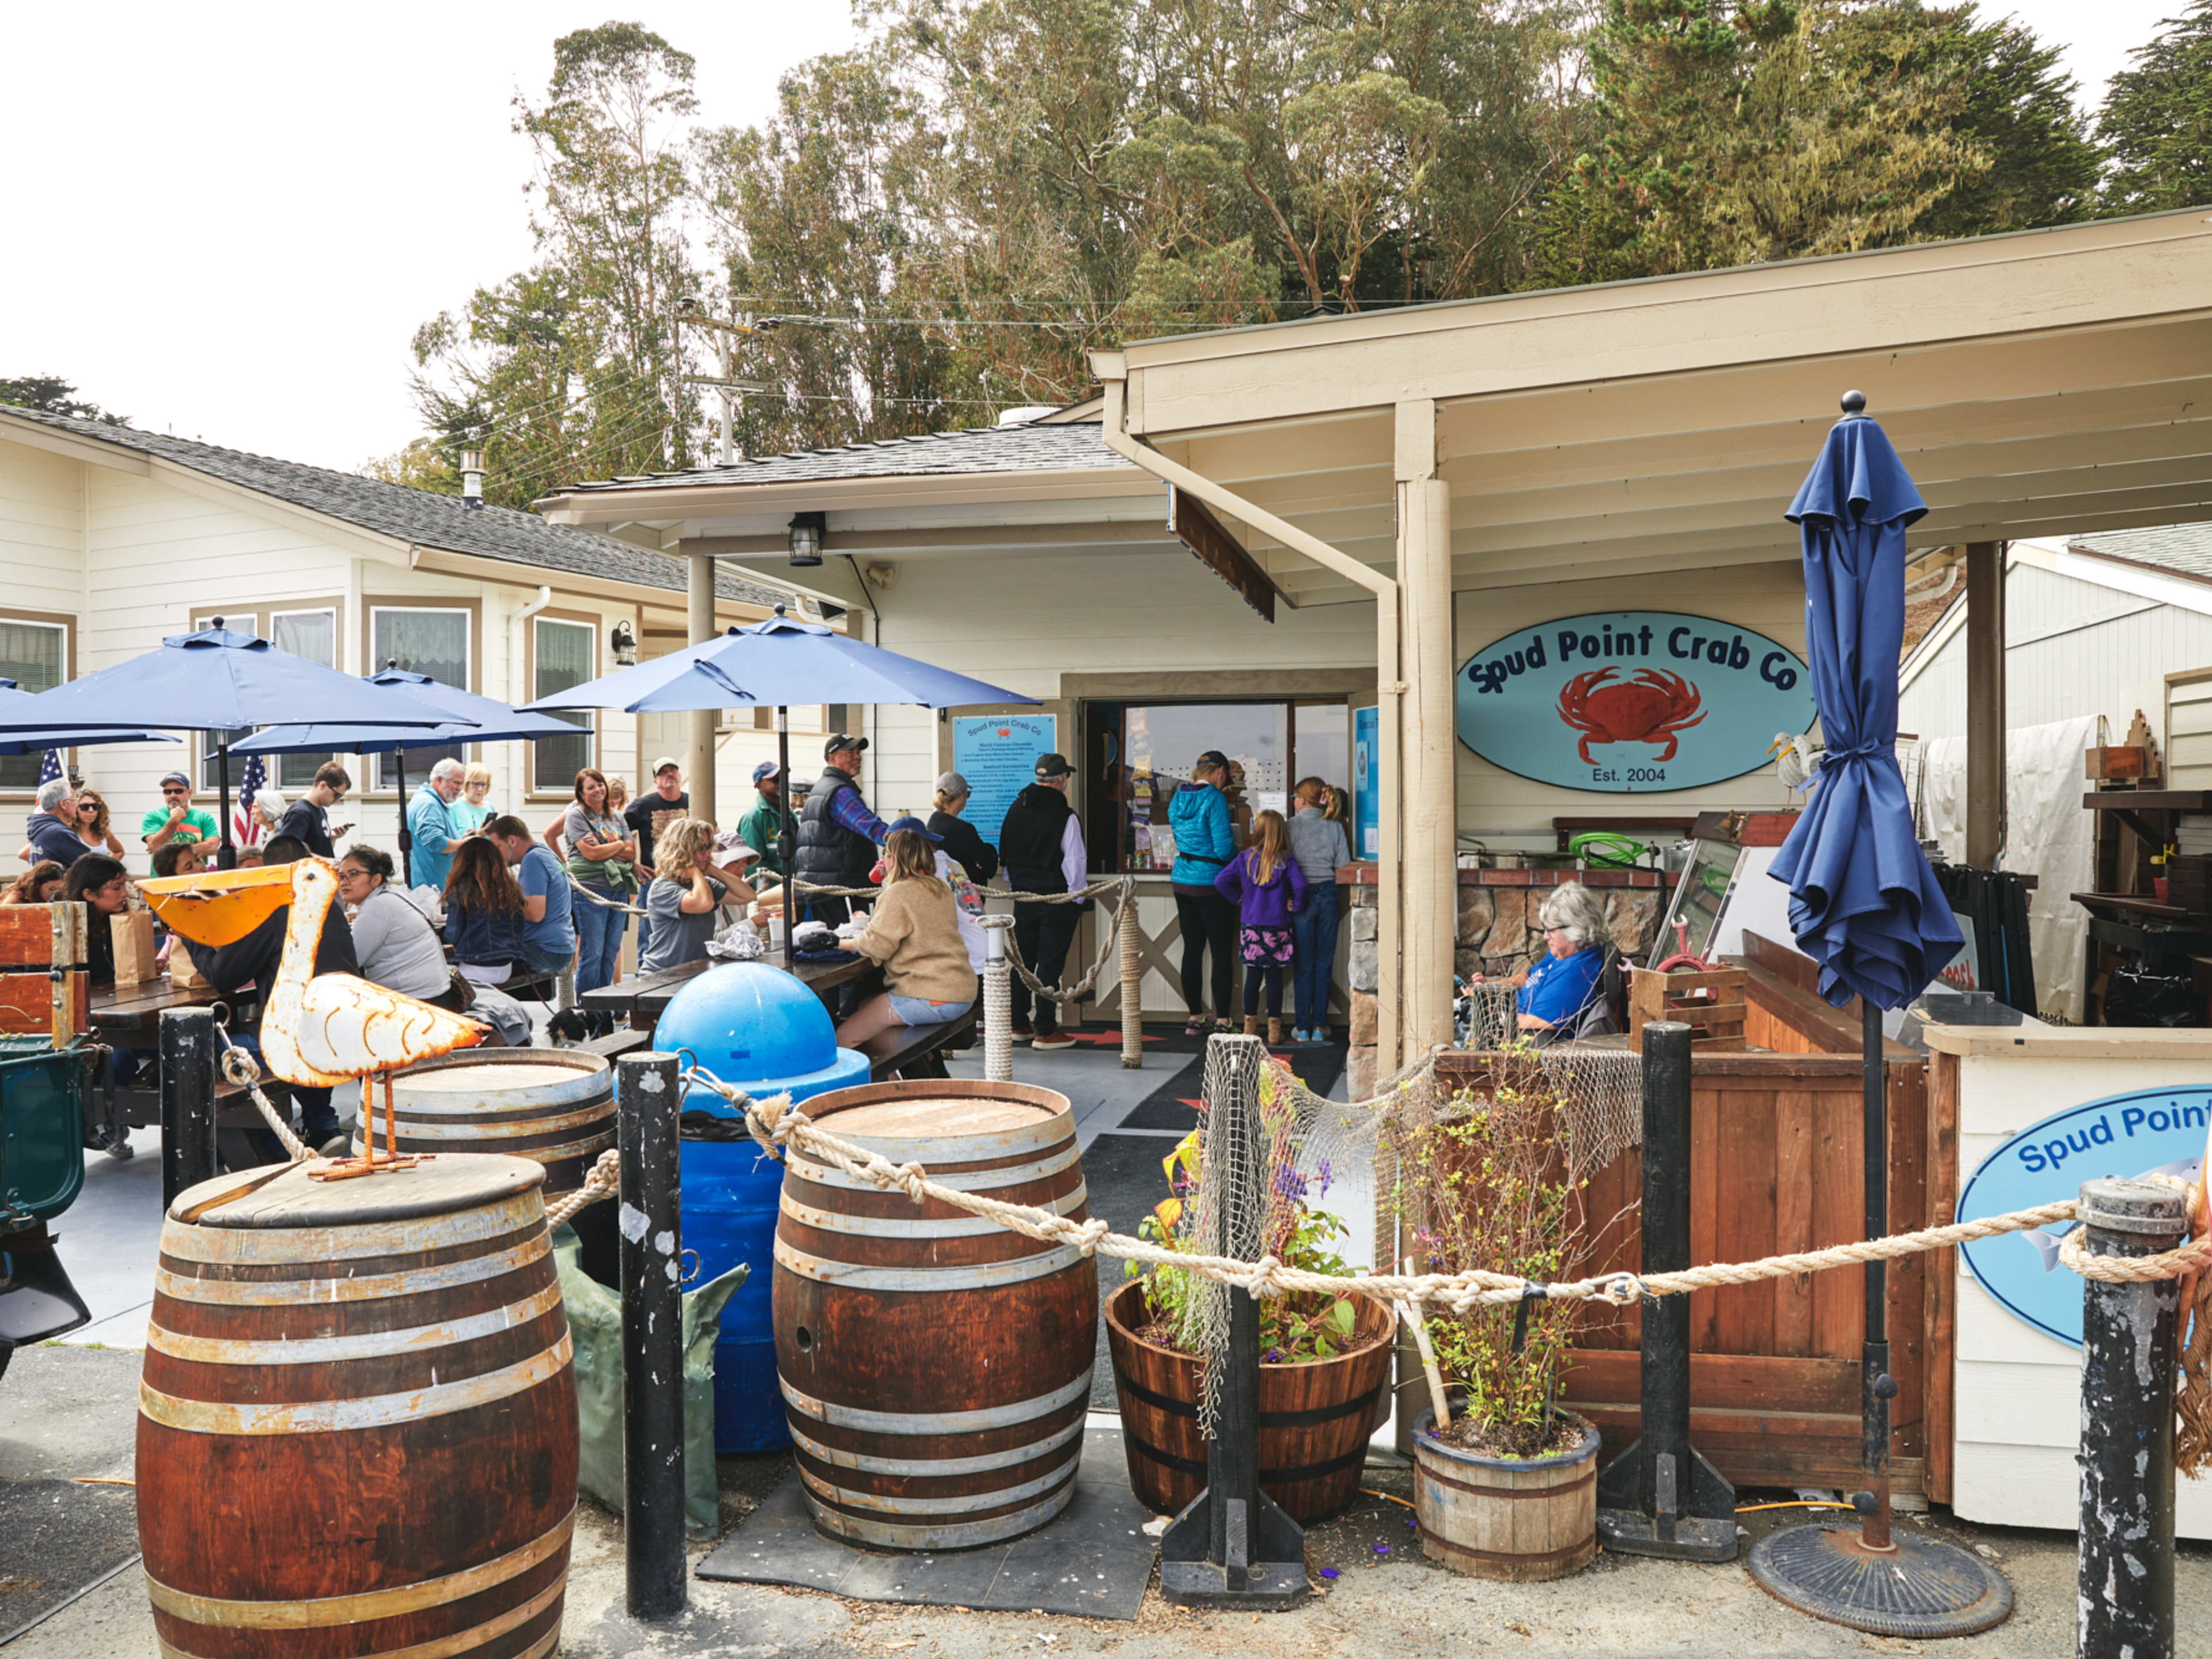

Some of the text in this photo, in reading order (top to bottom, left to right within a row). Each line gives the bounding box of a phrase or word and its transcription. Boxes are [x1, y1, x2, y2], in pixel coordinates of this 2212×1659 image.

[1468, 624, 1797, 694] Spud Point Crab Co
[968, 719, 1041, 737] Spud Point Crab Co
[1593, 768, 1666, 782] Est. 2004
[2018, 1115, 2113, 1173] Spud
